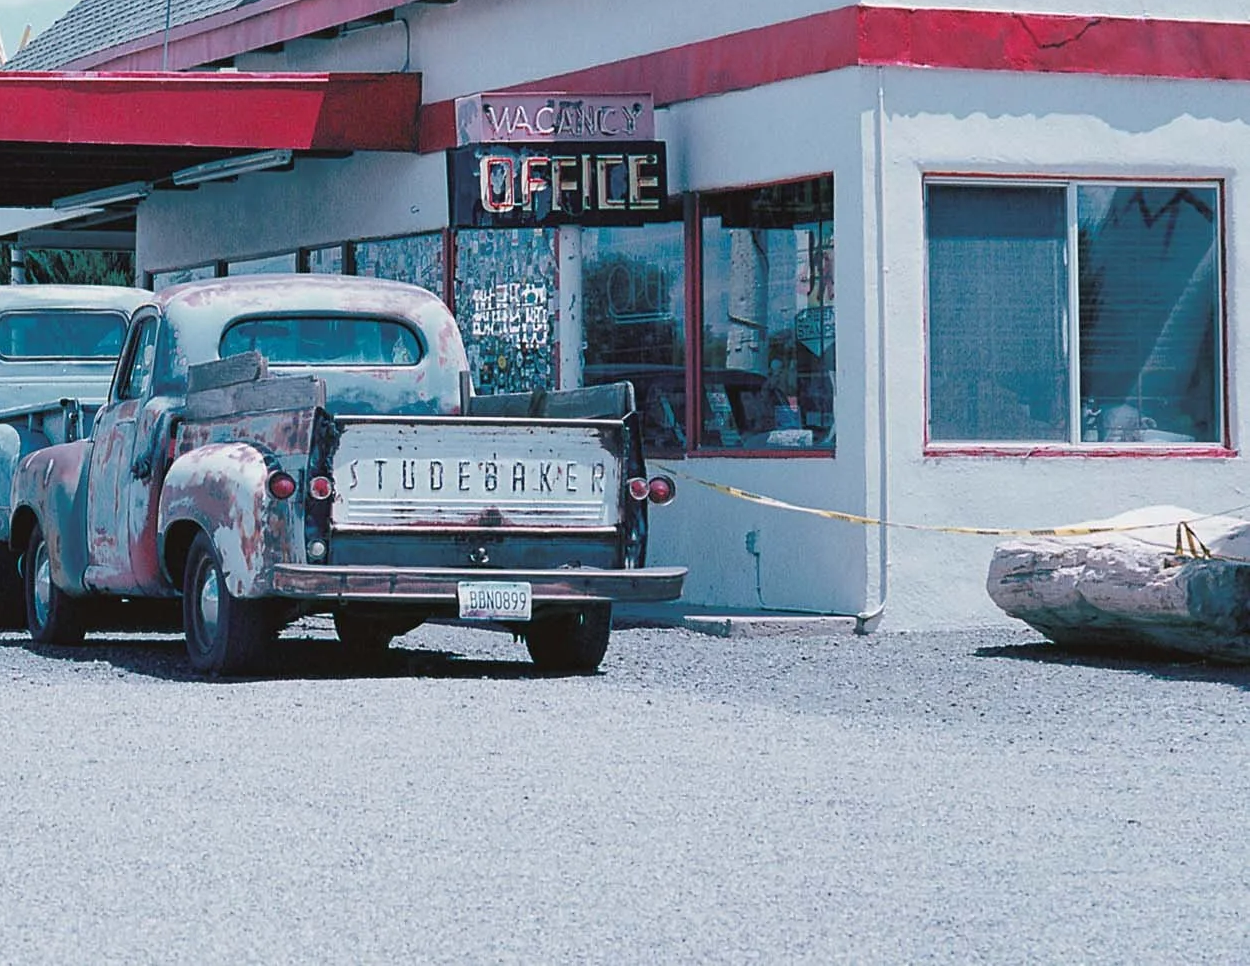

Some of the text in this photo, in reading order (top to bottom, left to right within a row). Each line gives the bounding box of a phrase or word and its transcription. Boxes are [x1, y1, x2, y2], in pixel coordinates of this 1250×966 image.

[488, 105, 642, 136] VACANCY
[480, 154, 659, 214] OFFICE
[349, 459, 605, 493] STUDEBAKER
[469, 590, 527, 611] BBN0899
